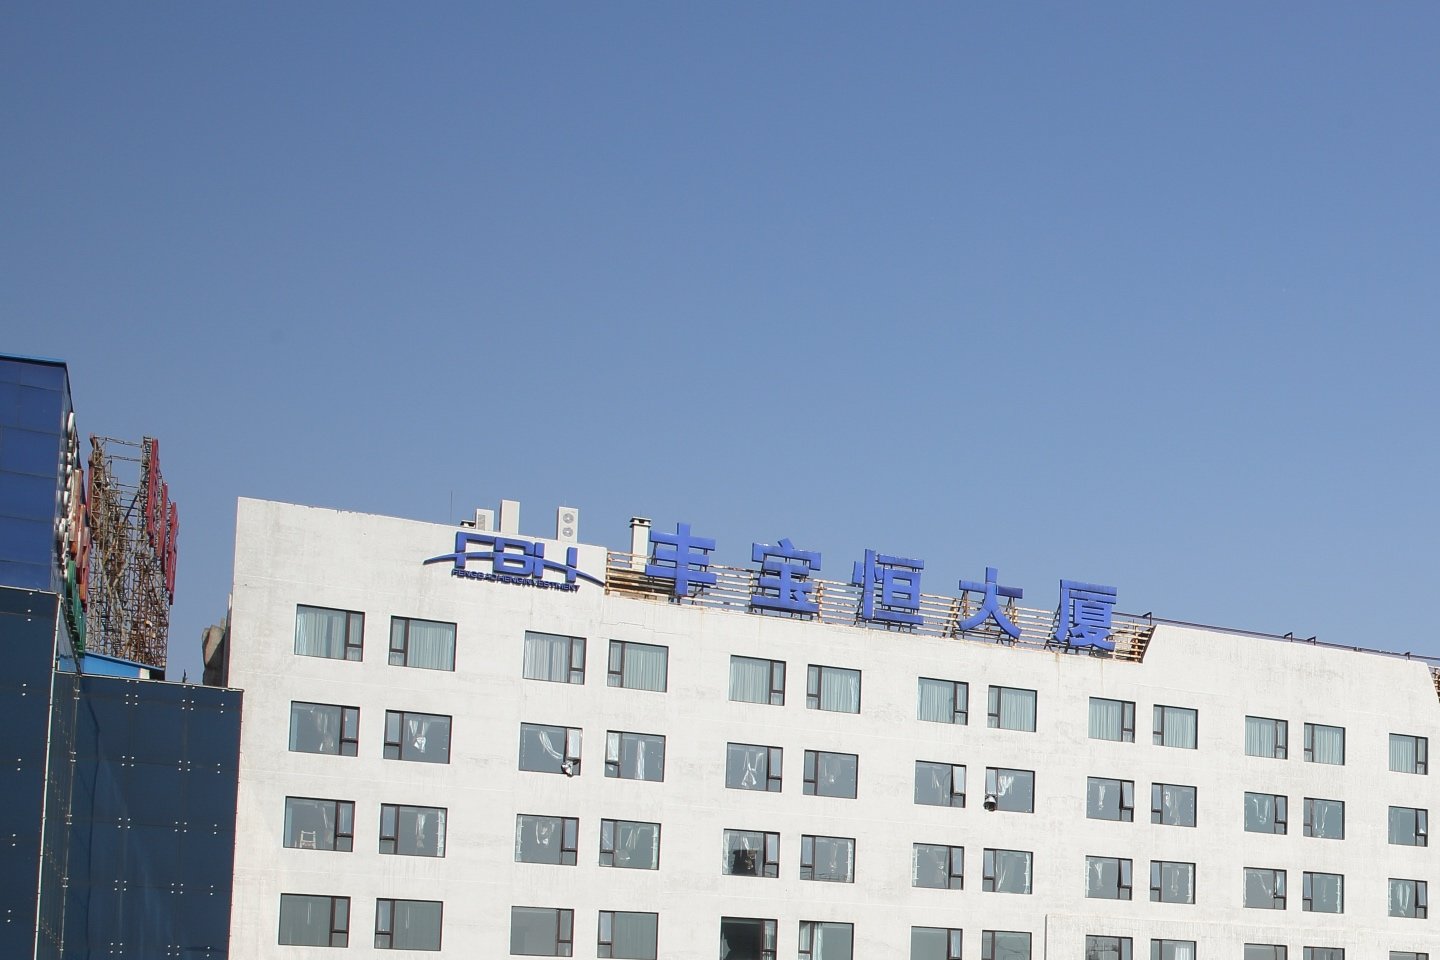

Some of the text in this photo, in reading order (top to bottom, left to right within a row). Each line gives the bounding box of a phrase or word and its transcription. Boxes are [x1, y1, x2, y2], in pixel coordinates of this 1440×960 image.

[455, 531, 579, 583] FBH
[645, 522, 1118, 652] 丰宝恒大厦
